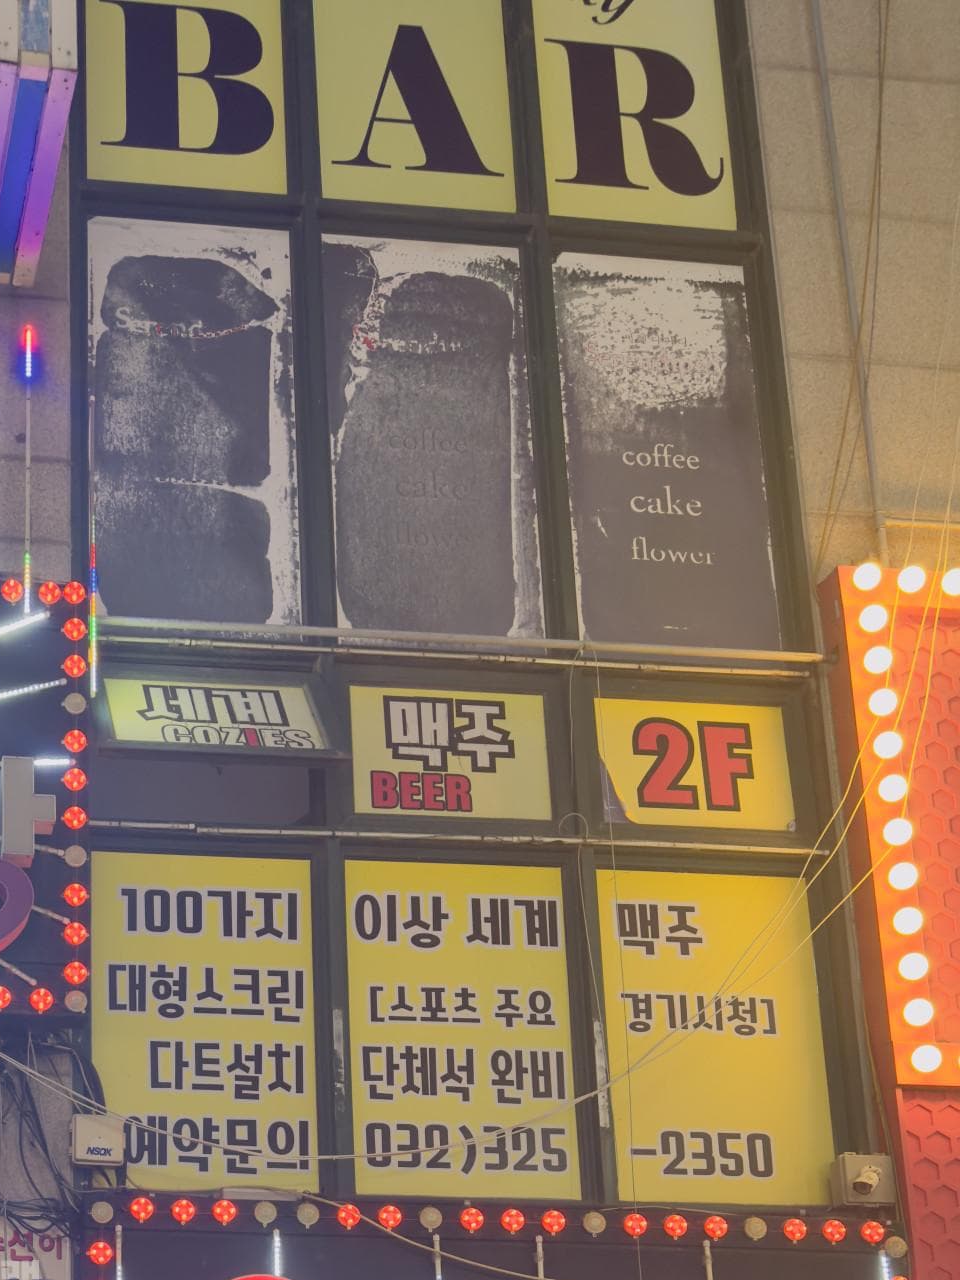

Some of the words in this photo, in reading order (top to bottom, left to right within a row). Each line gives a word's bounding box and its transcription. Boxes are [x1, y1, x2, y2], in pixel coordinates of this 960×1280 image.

[100, 0, 725, 197] BAR
[622, 444, 701, 470] coffee
[630, 486, 704, 517] cake
[631, 537, 715, 565] flower
[136, 685, 290, 727] 세계
[383, 695, 515, 773] 맥주
[371, 770, 473, 812] BEER
[632, 717, 756, 811] 2F
[120, 888, 299, 942] 100가지
[354, 893, 449, 949] 이상
[466, 897, 559, 948] 세계
[617, 901, 704, 956] 맥주
[107, 963, 305, 1021] 대형스크린
[370, 985, 481, 1025] [스포츠
[495, 988, 556, 1028] 주요
[623, 992, 776, 1036] 경기시청]
[149, 1039, 305, 1097] 다트설치
[362, 1044, 474, 1102] 단체석
[490, 1047, 566, 1105] 완비
[123, 1115, 310, 1174] 예약문의
[365, 1122, 569, 1176] 032)325
[631, 1130, 775, 1178] -2350
